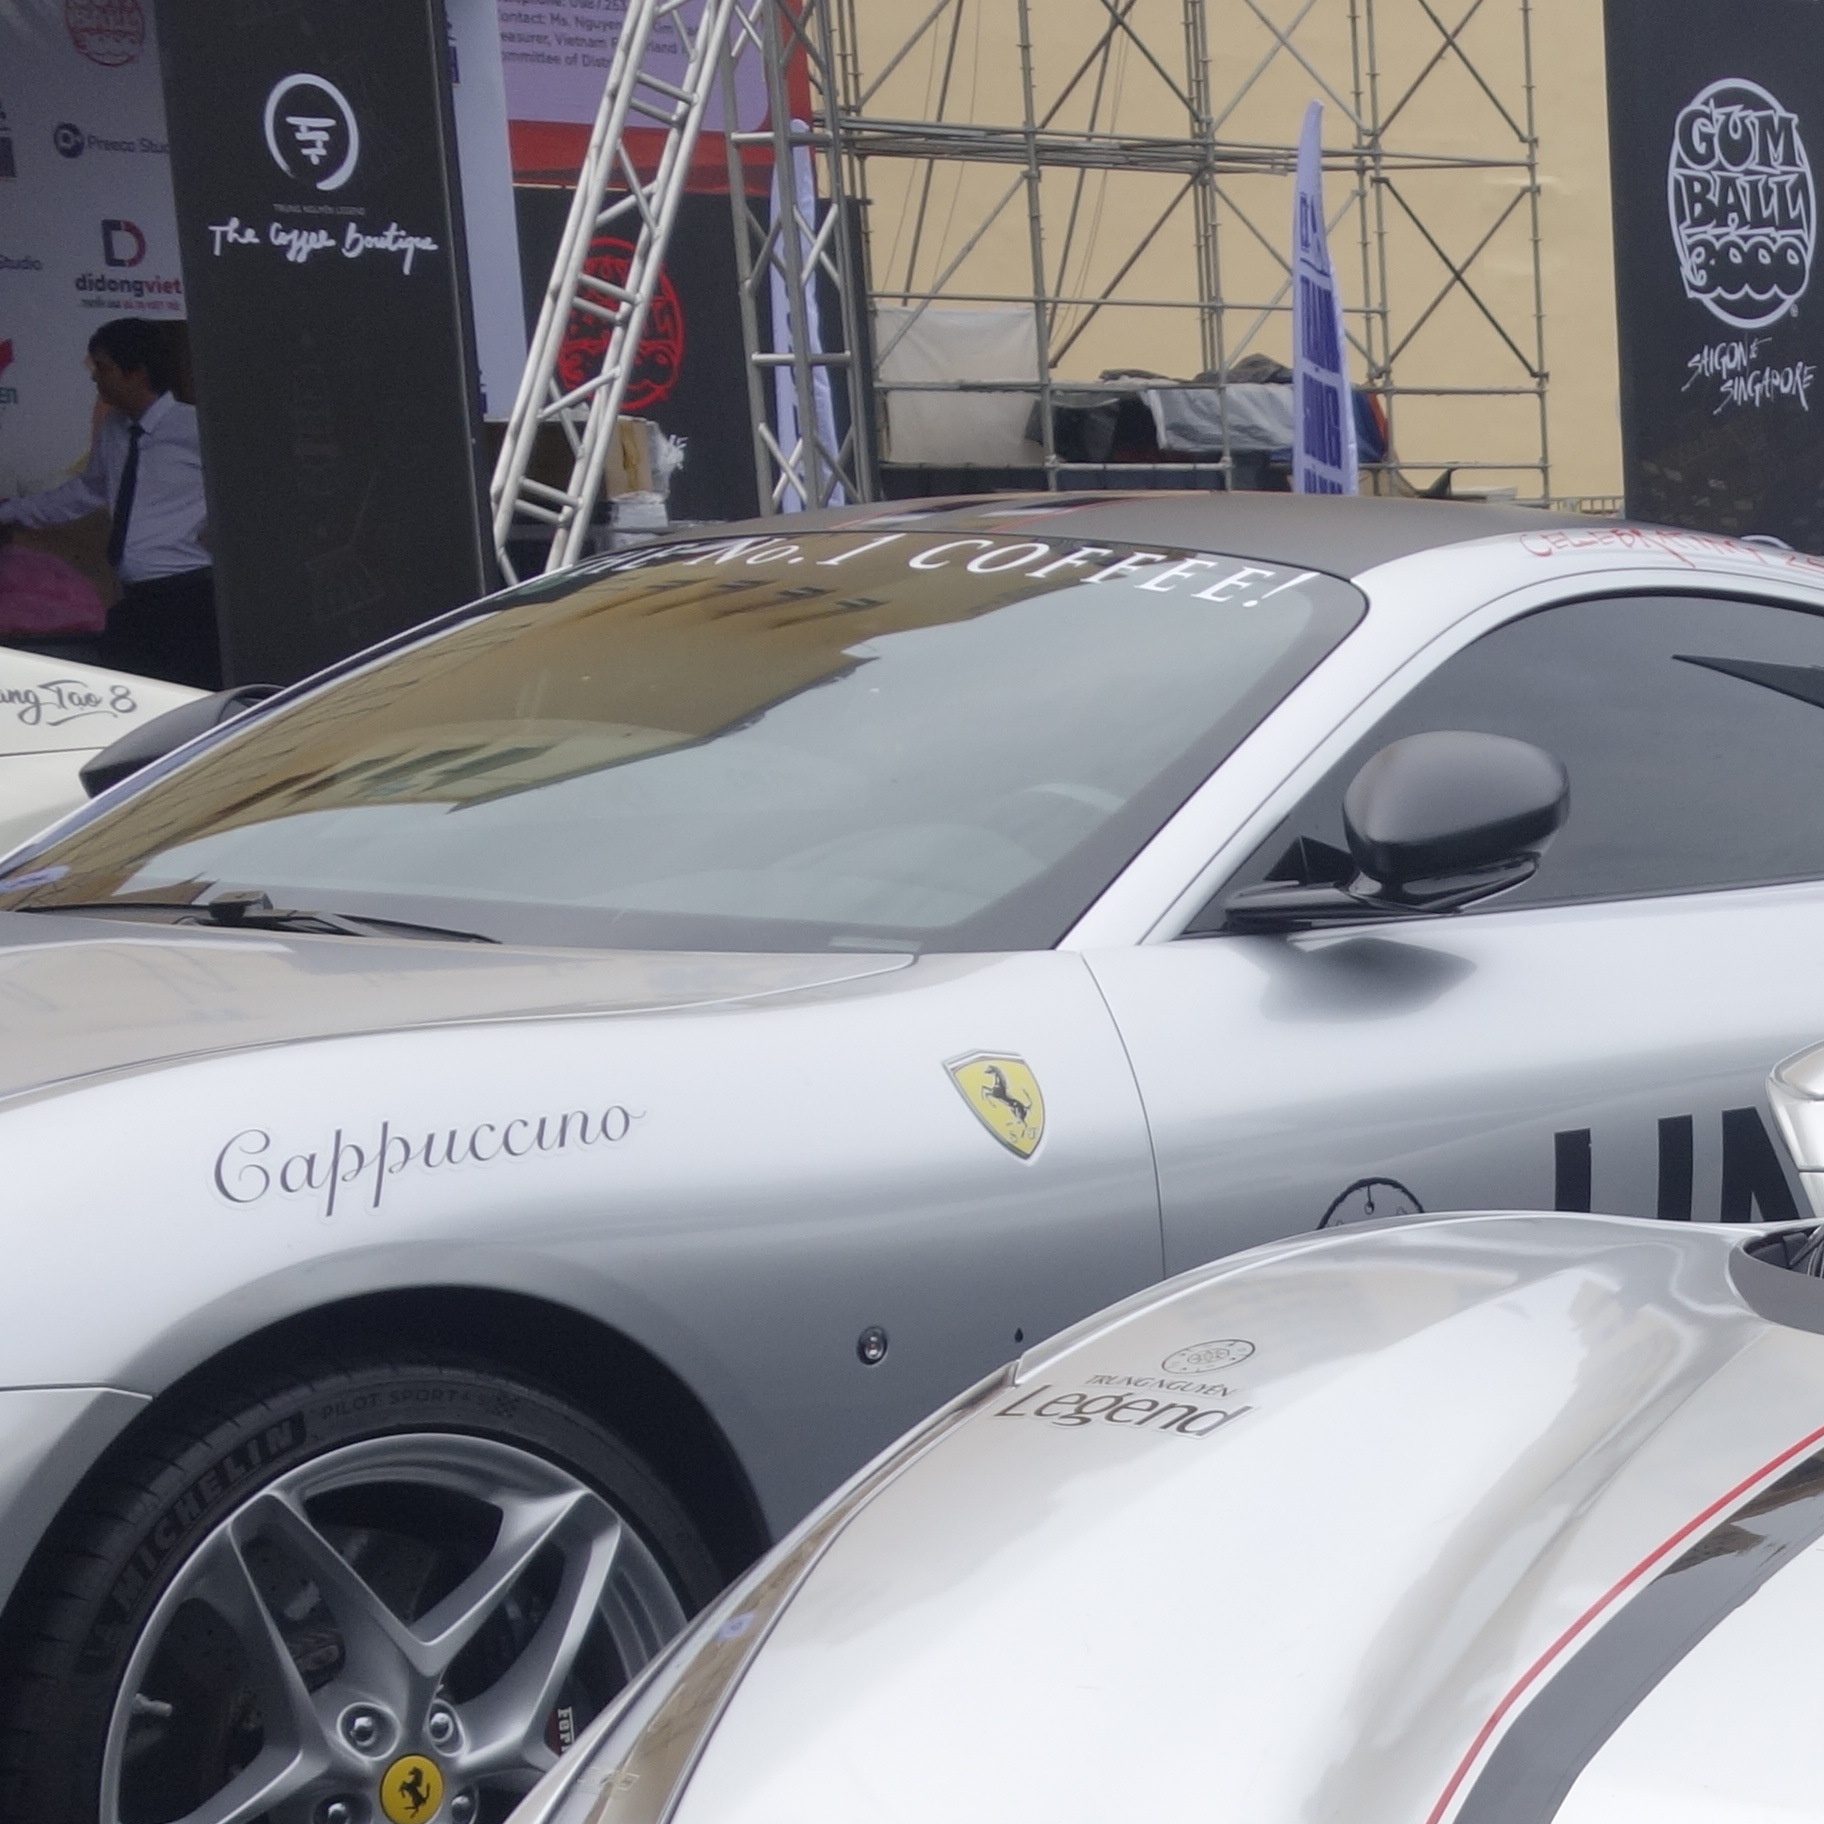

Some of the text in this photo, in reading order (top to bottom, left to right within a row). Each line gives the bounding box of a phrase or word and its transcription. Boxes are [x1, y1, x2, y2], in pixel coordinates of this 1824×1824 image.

[75, 273, 183, 297] didongviet
[908, 537, 1320, 611] COFFEE!
[109, 684, 138, 714] 8
[214, 1097, 647, 1218] Cappuccino
[993, 1383, 1254, 1438] Legend
[116, 1412, 298, 1612] MICHELIN
